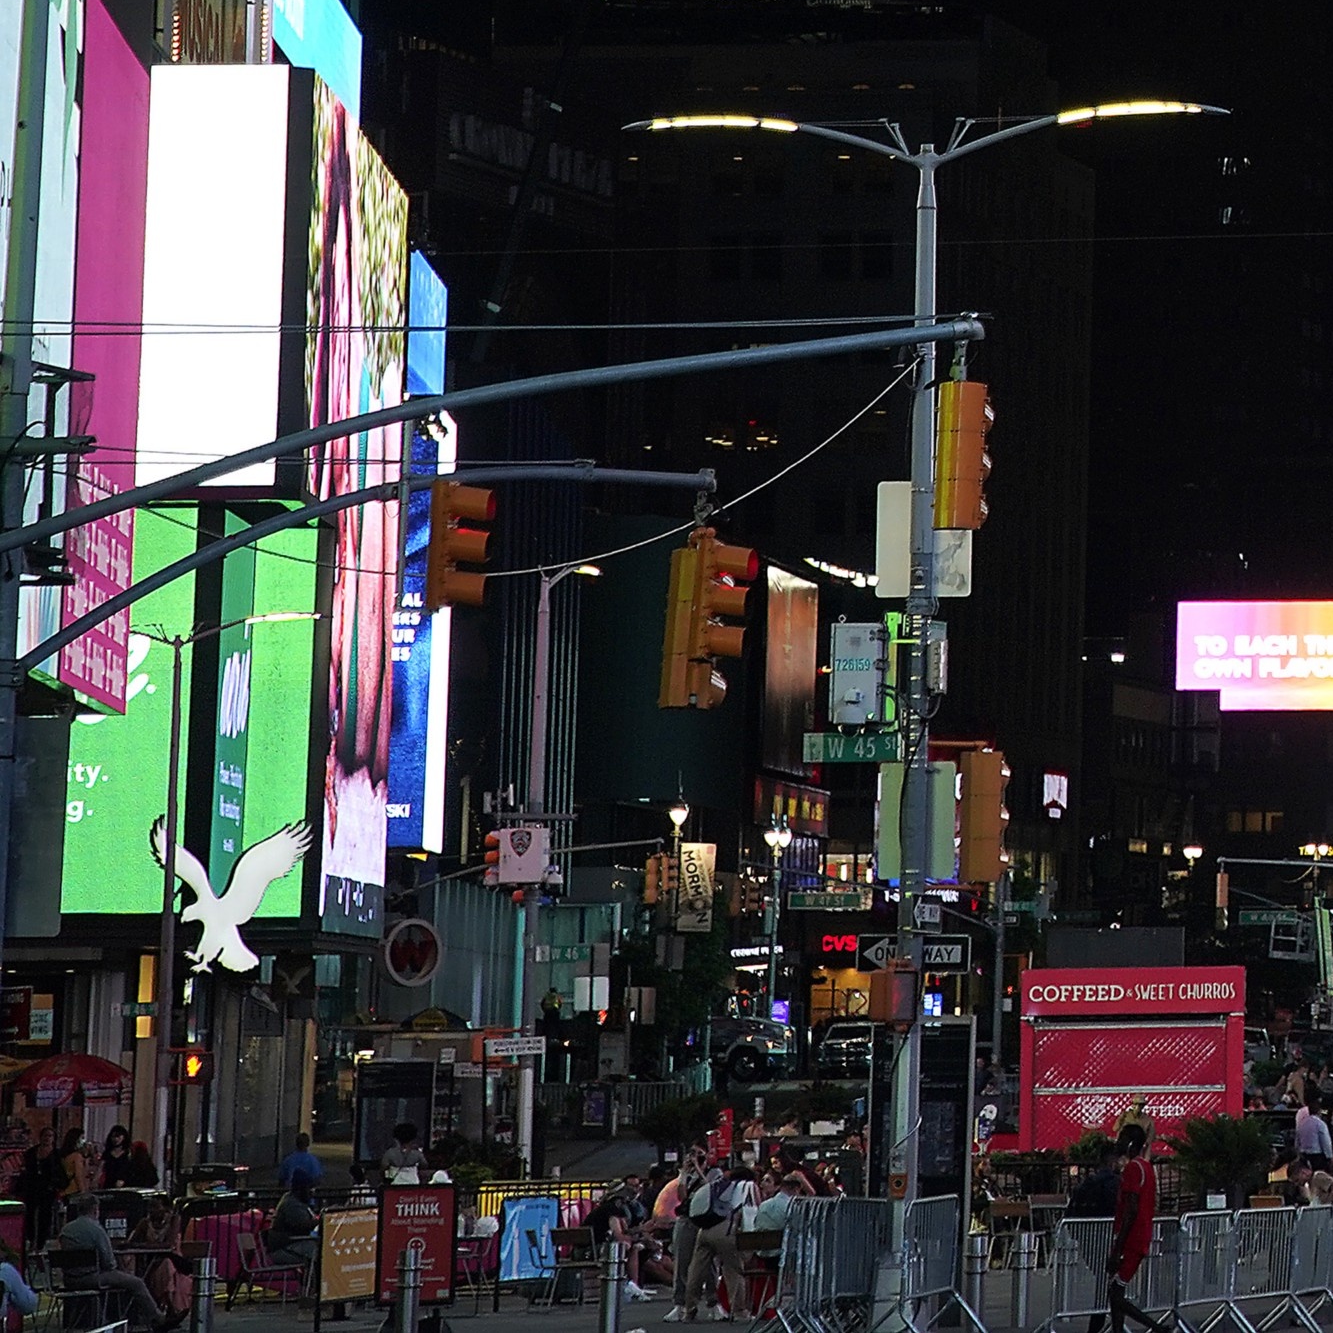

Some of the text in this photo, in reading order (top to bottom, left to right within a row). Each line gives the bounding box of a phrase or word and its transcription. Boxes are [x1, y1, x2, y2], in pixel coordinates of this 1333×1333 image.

[1194, 635, 1227, 656] TO
[1234, 635, 1298, 656] EACH
[1193, 657, 1253, 678] OWN
[828, 737, 896, 758] W 45 St
[822, 934, 857, 952] CVS
[875, 946, 955, 962] ON WAY
[1028, 984, 1124, 1002] COFFEED
[1134, 983, 1175, 1001] SWEET
[1178, 982, 1236, 1000] CHURROS
[395, 1202, 440, 1216] THINK
